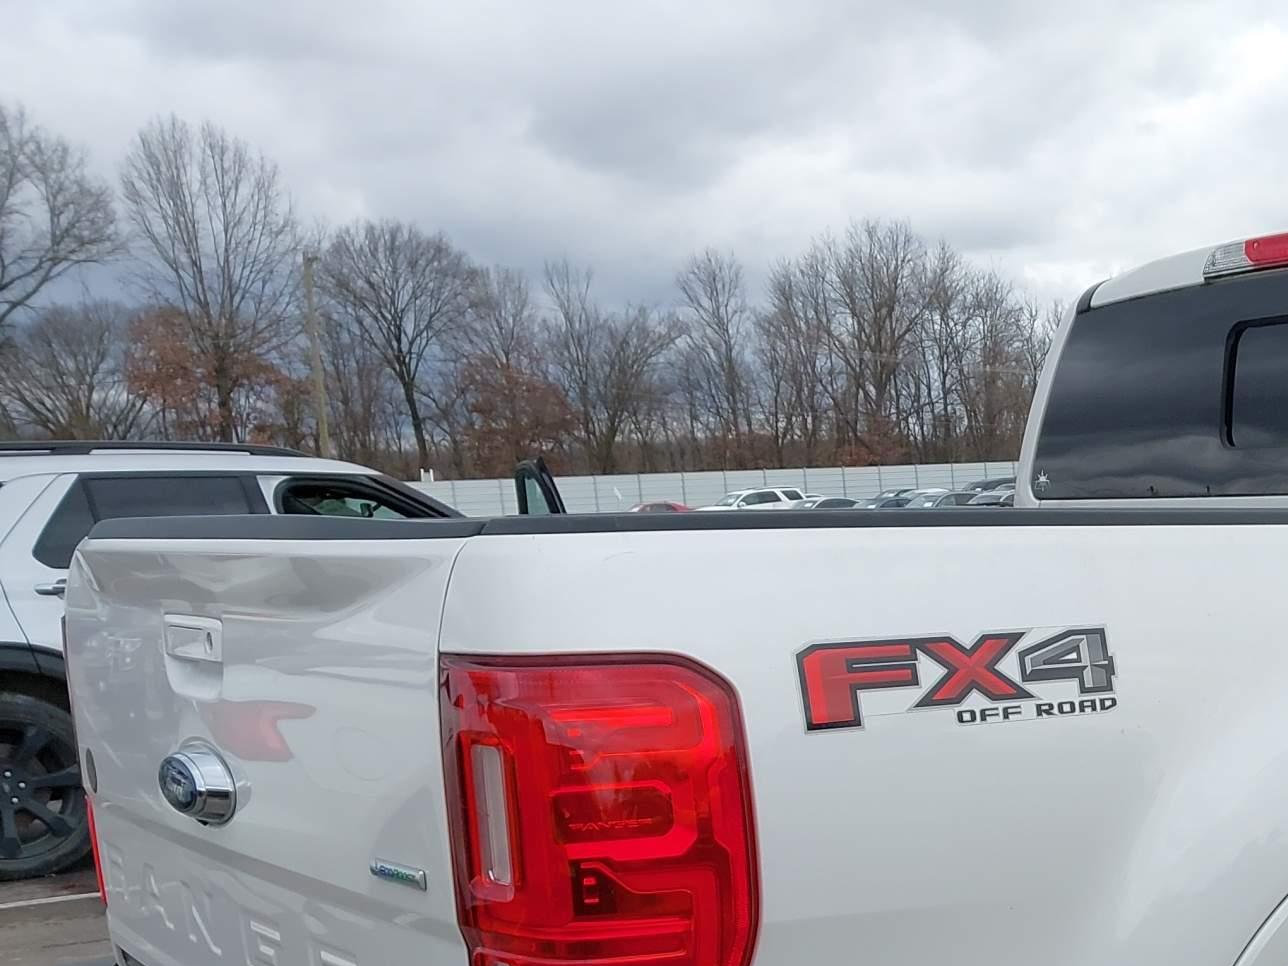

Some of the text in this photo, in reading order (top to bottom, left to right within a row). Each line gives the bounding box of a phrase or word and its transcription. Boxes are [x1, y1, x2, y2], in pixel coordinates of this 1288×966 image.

[795, 627, 1115, 732] FX4
[956, 697, 1118, 726] OFF ROAD
